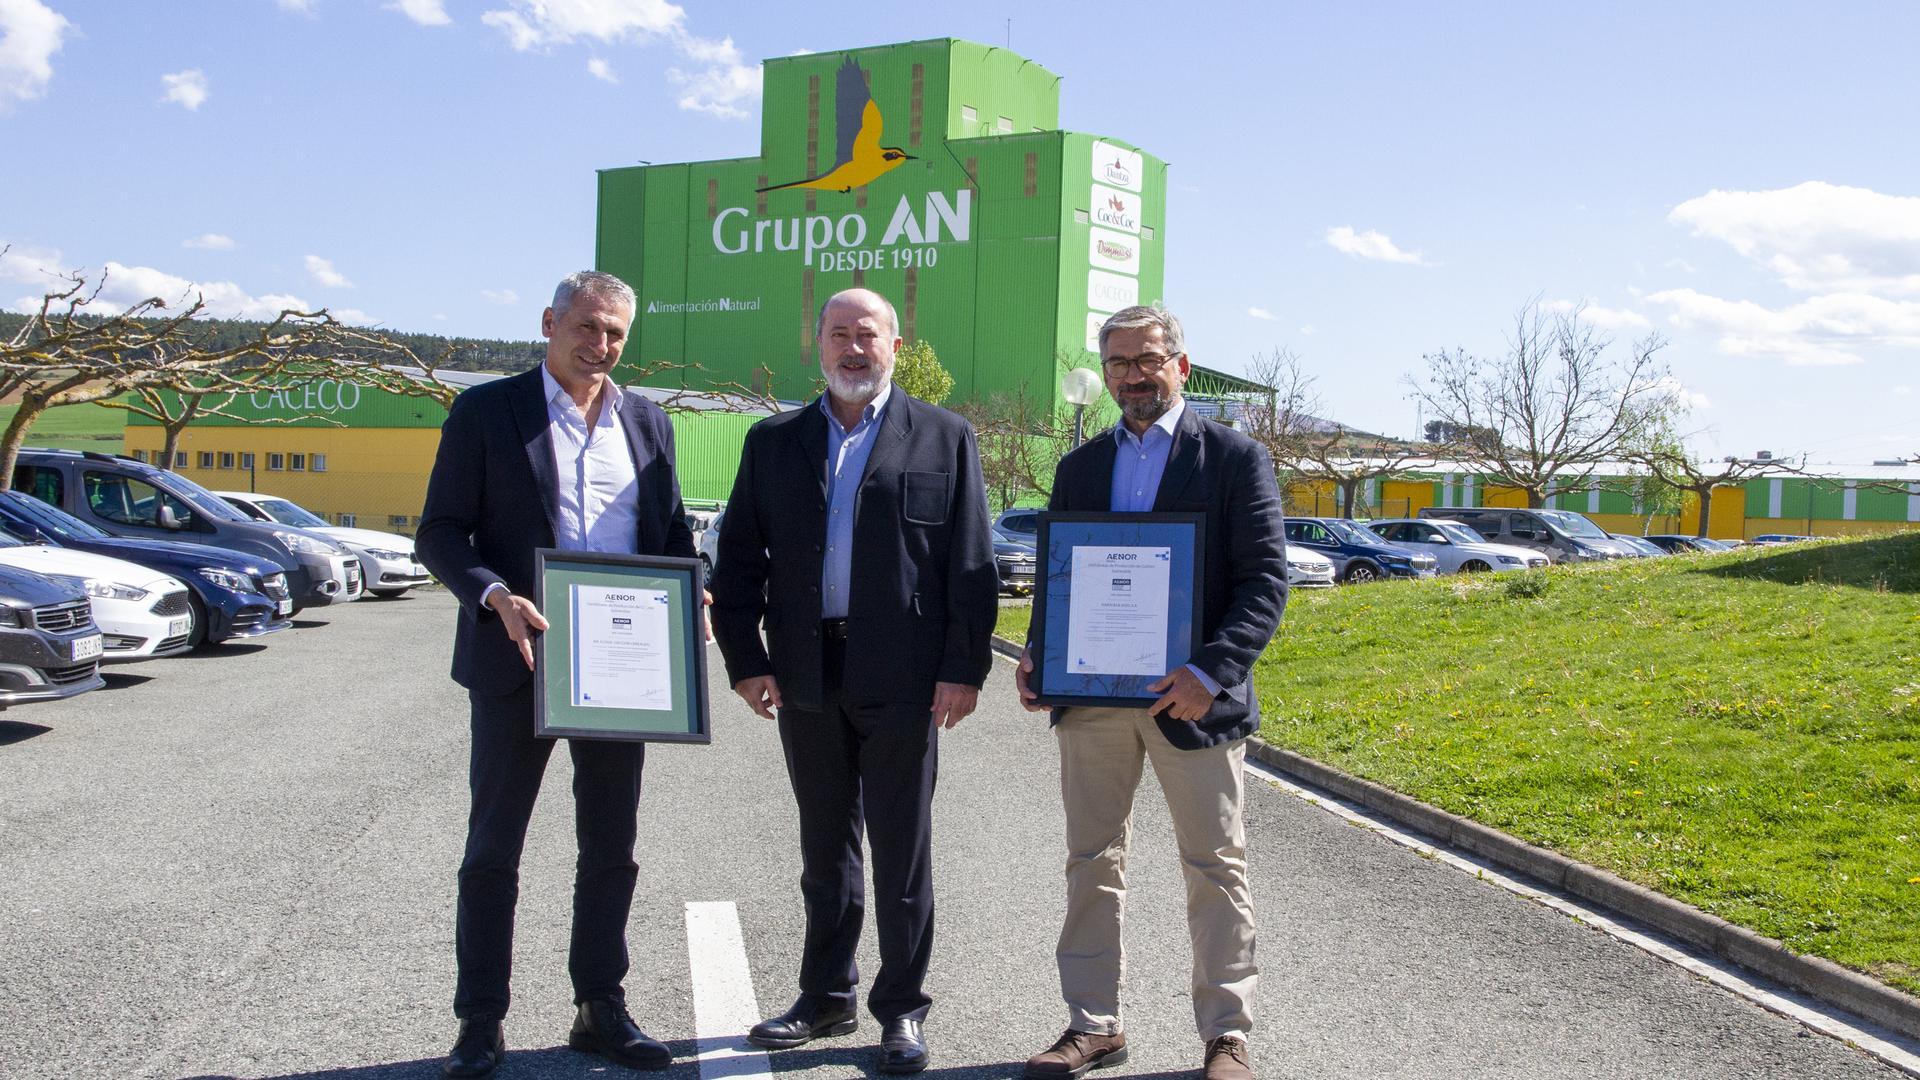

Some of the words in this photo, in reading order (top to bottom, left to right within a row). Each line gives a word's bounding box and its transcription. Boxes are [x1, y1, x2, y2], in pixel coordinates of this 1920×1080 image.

[712, 206, 867, 266] Grupo
[881, 189, 971, 245] AN
[820, 250, 884, 273] DESDE
[891, 247, 938, 269] 1910
[647, 299, 719, 314] Alimentación
[719, 296, 761, 312] Natural
[250, 379, 361, 410] CACECO
